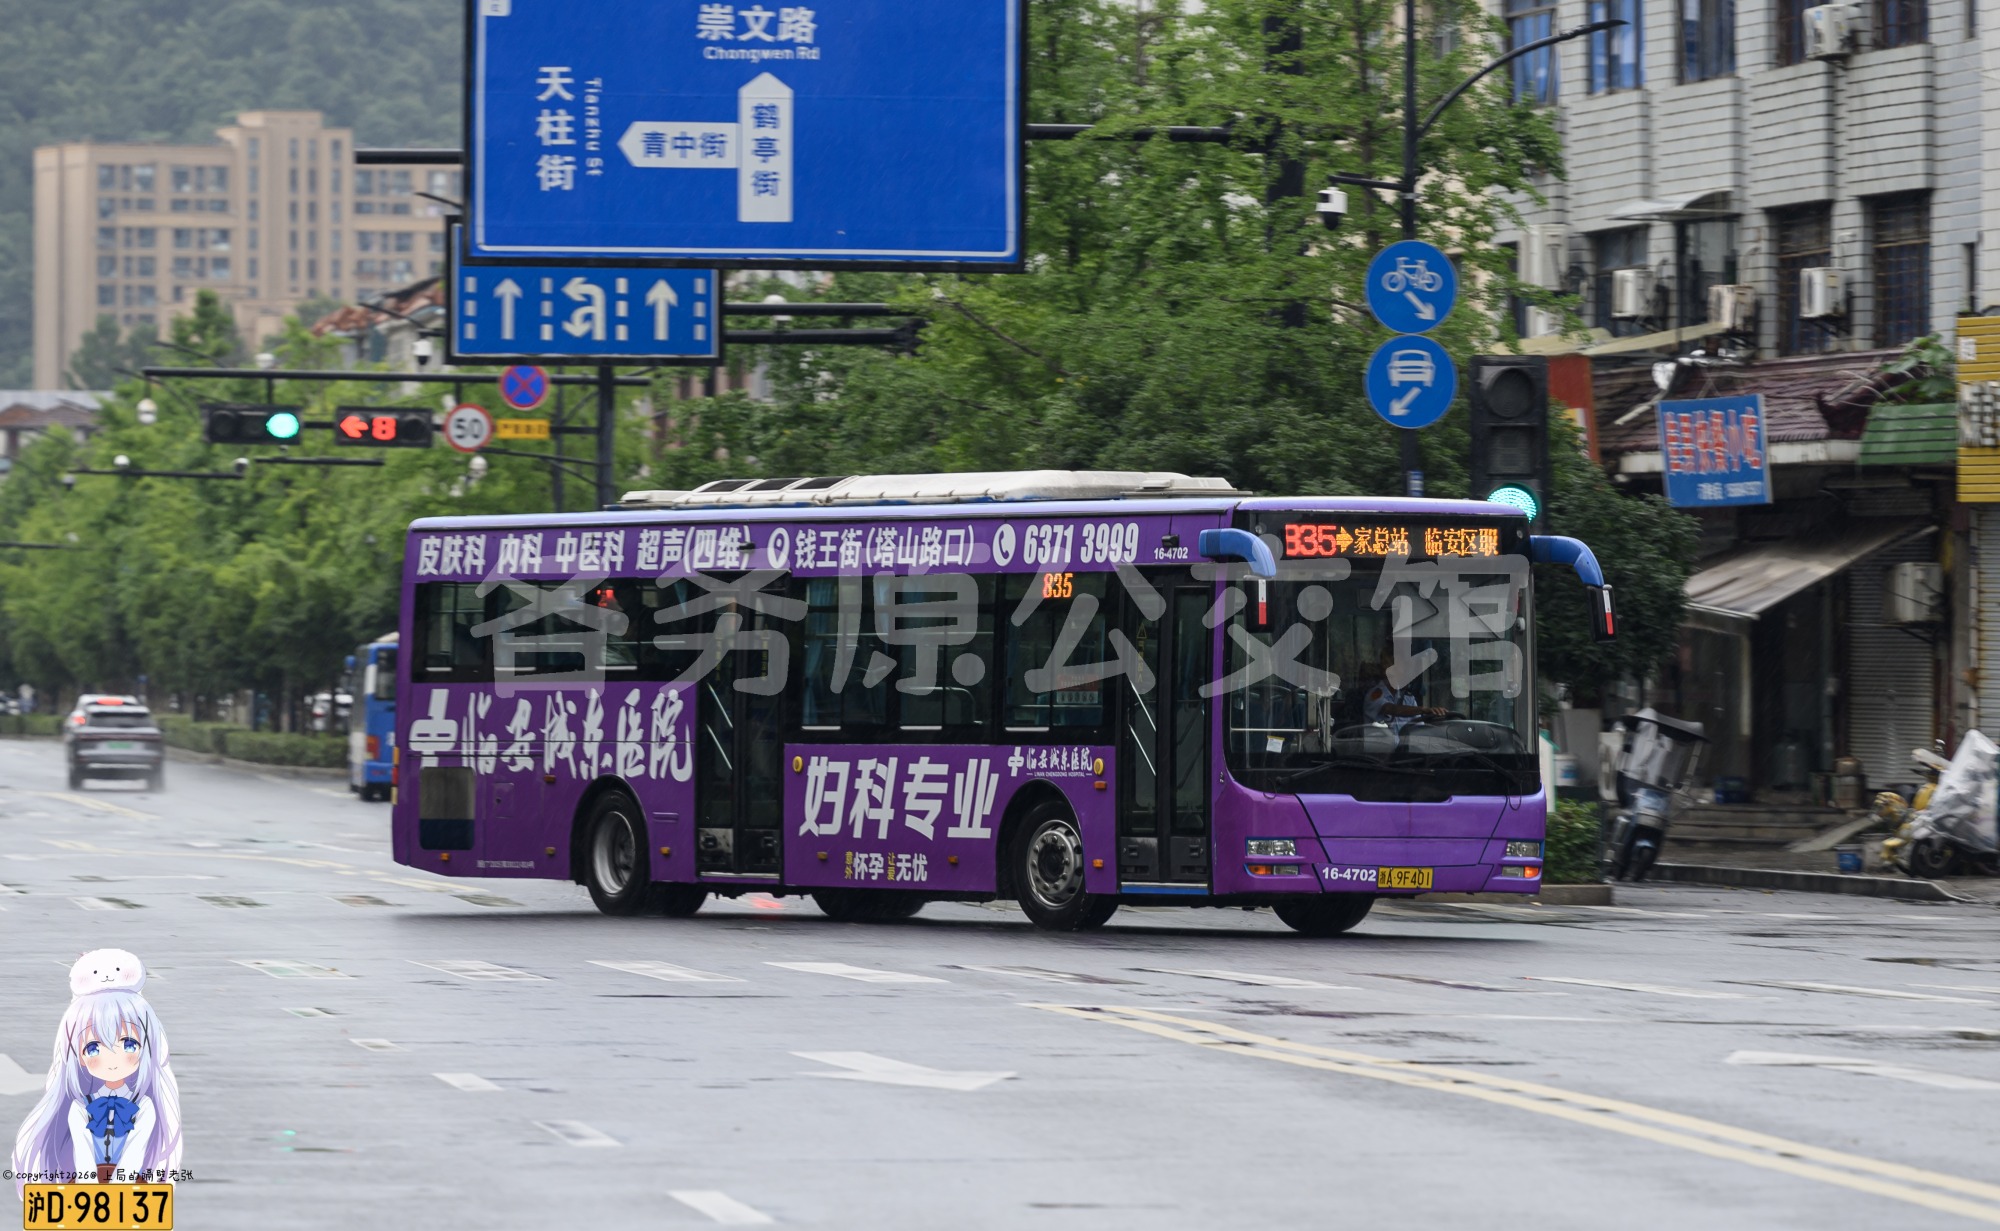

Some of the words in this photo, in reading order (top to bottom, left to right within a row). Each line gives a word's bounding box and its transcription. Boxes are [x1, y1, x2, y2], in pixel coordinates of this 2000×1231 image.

[696, 3, 818, 43] 崇文路
[703, 46, 794, 63] Chongwen
[796, 46, 820, 59] Rd
[535, 66, 577, 191] 天柱街
[641, 131, 728, 158] 青中街
[751, 103, 780, 196] 鹤亭街
[372, 416, 396, 440] 8
[454, 418, 483, 439] 50
[417, 533, 486, 576] 皮肤科
[498, 532, 543, 574] 内科
[555, 530, 626, 573] 中医科
[635, 525, 751, 574] 超声(四维)
[794, 525, 975, 569] 钱王街(塔山路口)
[1023, 524, 1074, 564] 6371
[1080, 522, 1140, 564] 3999
[1153, 547, 1189, 560] 16-4702
[1354, 527, 1409, 555] 家总站
[1042, 572, 1073, 598] 835
[799, 756, 999, 841] 妇科专业
[896, 853, 928, 881] 无忧
[1322, 867, 1377, 882] 16-4702
